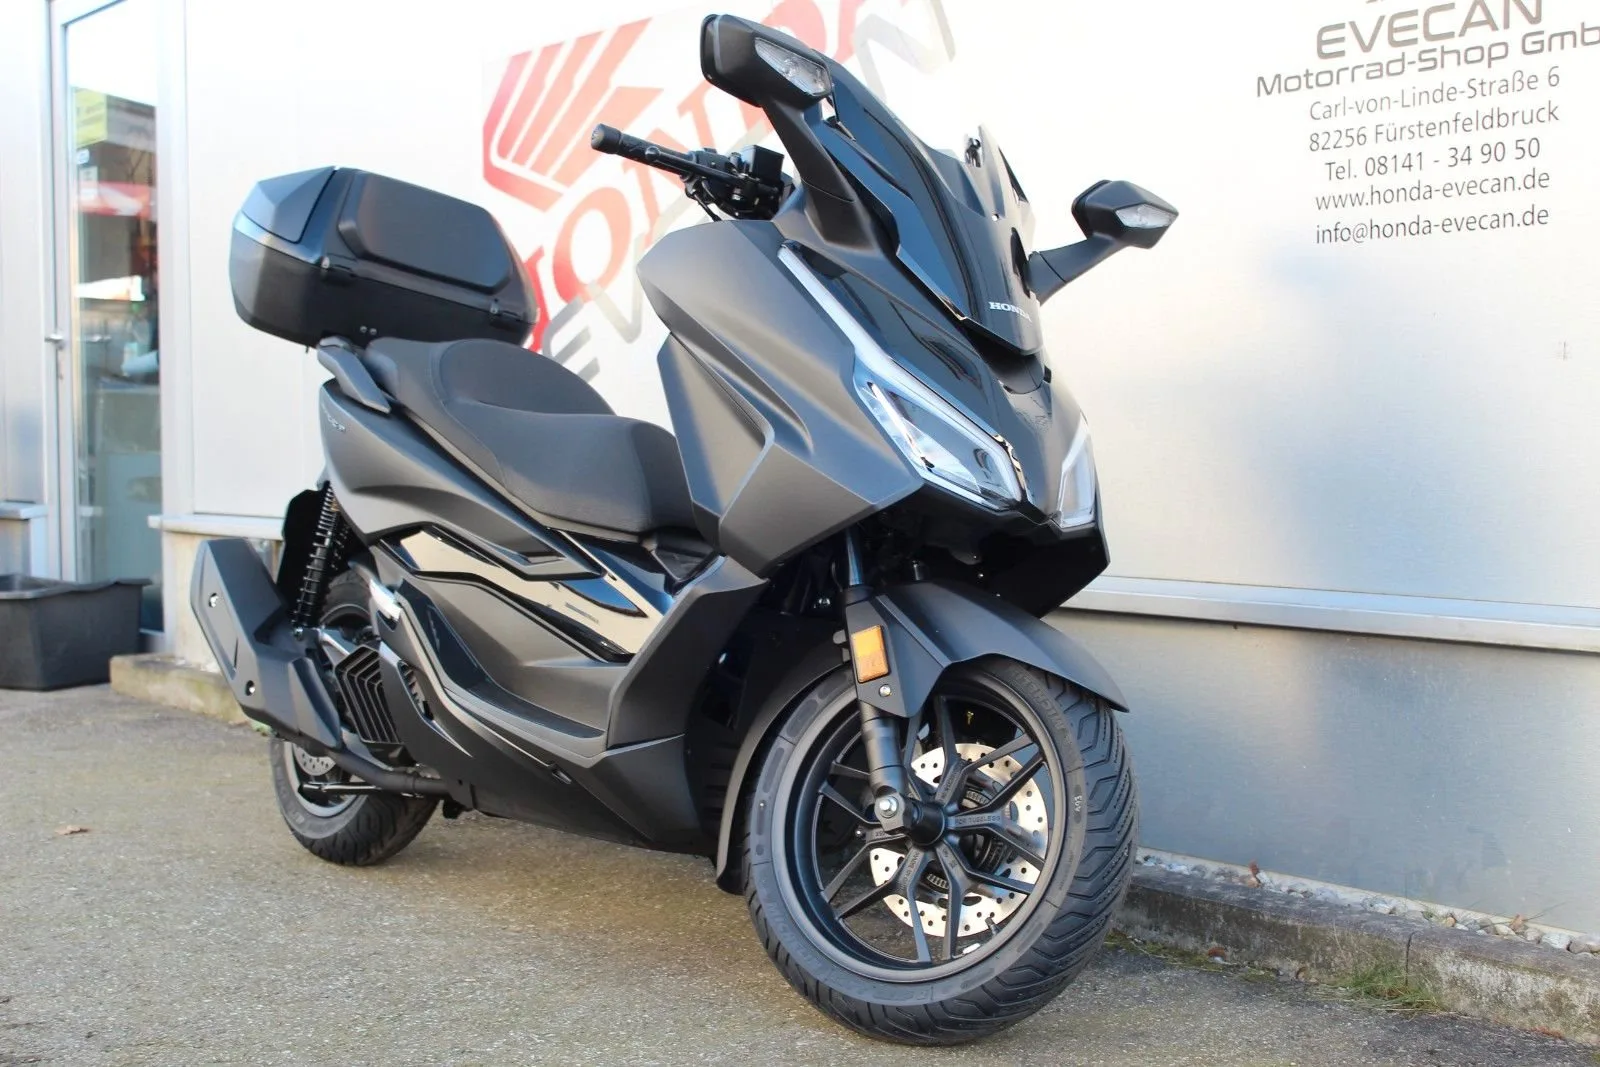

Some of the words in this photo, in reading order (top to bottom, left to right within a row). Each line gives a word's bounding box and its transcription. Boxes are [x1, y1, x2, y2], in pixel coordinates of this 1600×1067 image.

[1316, 0, 1543, 60] EVECAN
[1256, 41, 1510, 98] Motorrad-Shop
[1309, 69, 1540, 121] Carl-von-Linde-Straße
[1547, 66, 1561, 88] 6
[1308, 125, 1368, 153] 82256
[1374, 99, 1560, 145] Fürstenfeldbruck
[1324, 159, 1358, 182] Tel.
[1364, 151, 1424, 178] 08141
[1447, 146, 1473, 169] 34
[1480, 141, 1507, 165] 90
[1514, 137, 1541, 161] 50
[1315, 167, 1551, 211] www.honda-evecan.de
[1315, 203, 1550, 245] info@honda-evecan.de
[988, 301, 1033, 323] HONDA
